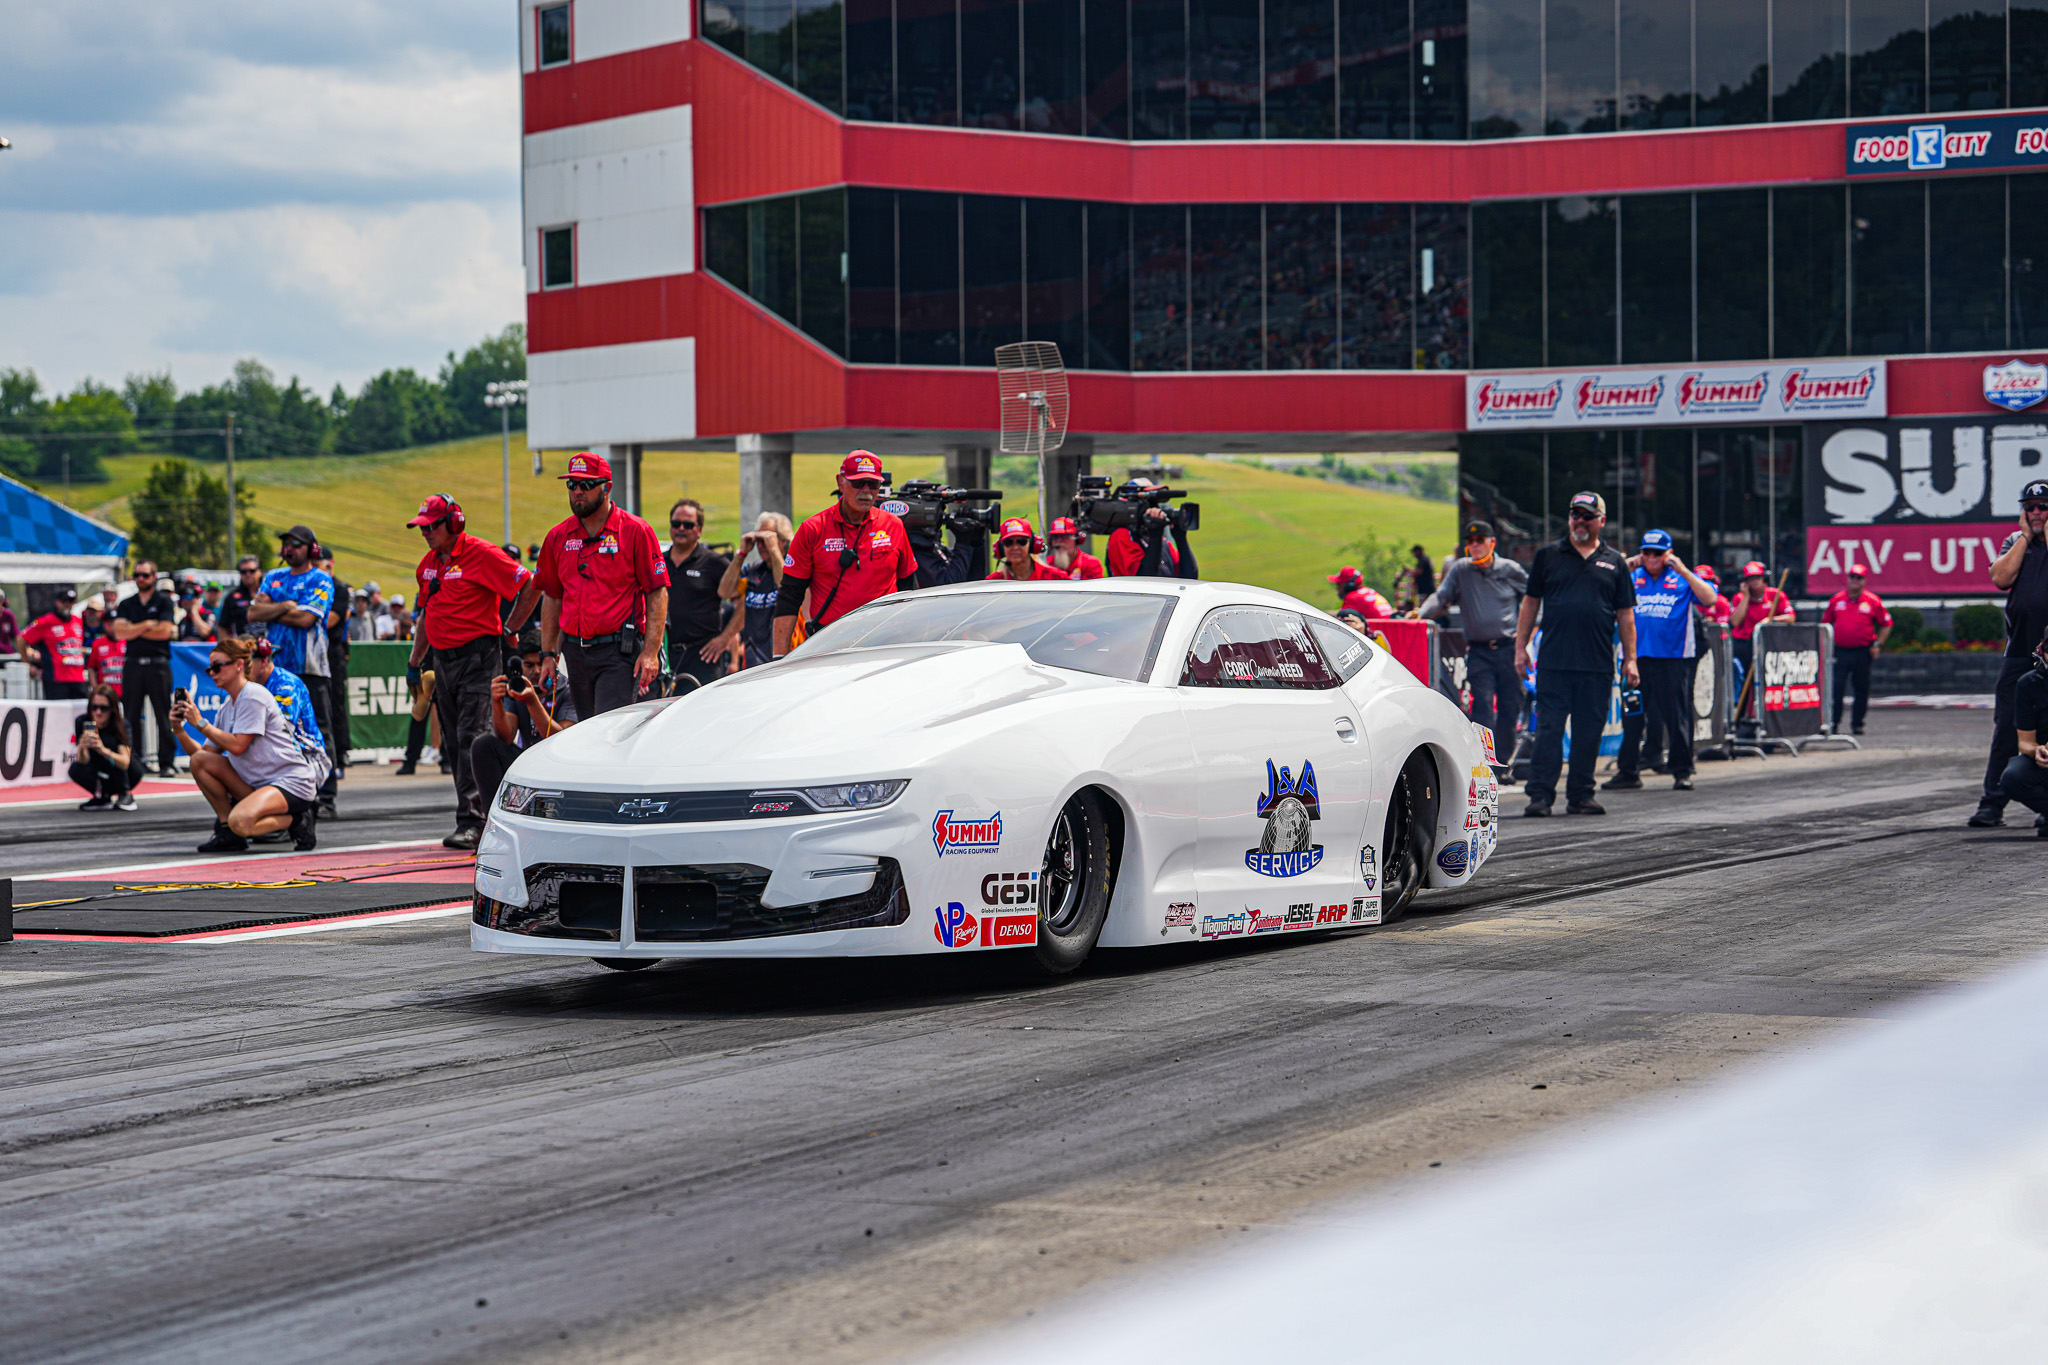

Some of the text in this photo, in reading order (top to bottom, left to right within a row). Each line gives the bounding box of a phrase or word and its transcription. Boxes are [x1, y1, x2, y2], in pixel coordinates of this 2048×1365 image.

[1856, 138, 1909, 161] FOOD
[1945, 132, 1989, 156] CITY
[2016, 130, 2048, 153] FO
[1808, 538, 1894, 575] ATV
[1304, 653, 1318, 663] PRO
[1225, 661, 1250, 677] CORY
[1278, 663, 1304, 678] REED
[0, 707, 53, 780] OL
[1257, 758, 1320, 818] J&A
[1248, 850, 1320, 876] SERVICE
[1015, 906, 1029, 914] Systems
[1285, 903, 1314, 923] JESEL
[1316, 904, 1348, 923] ARP
[1363, 909, 1378, 918] DAMPER
[1366, 901, 1377, 909] SUPER
[935, 902, 965, 948] VP
[955, 924, 979, 943] Racing
[1000, 924, 1032, 937] DENSO
[1202, 913, 1245, 940] MagnaFuel
